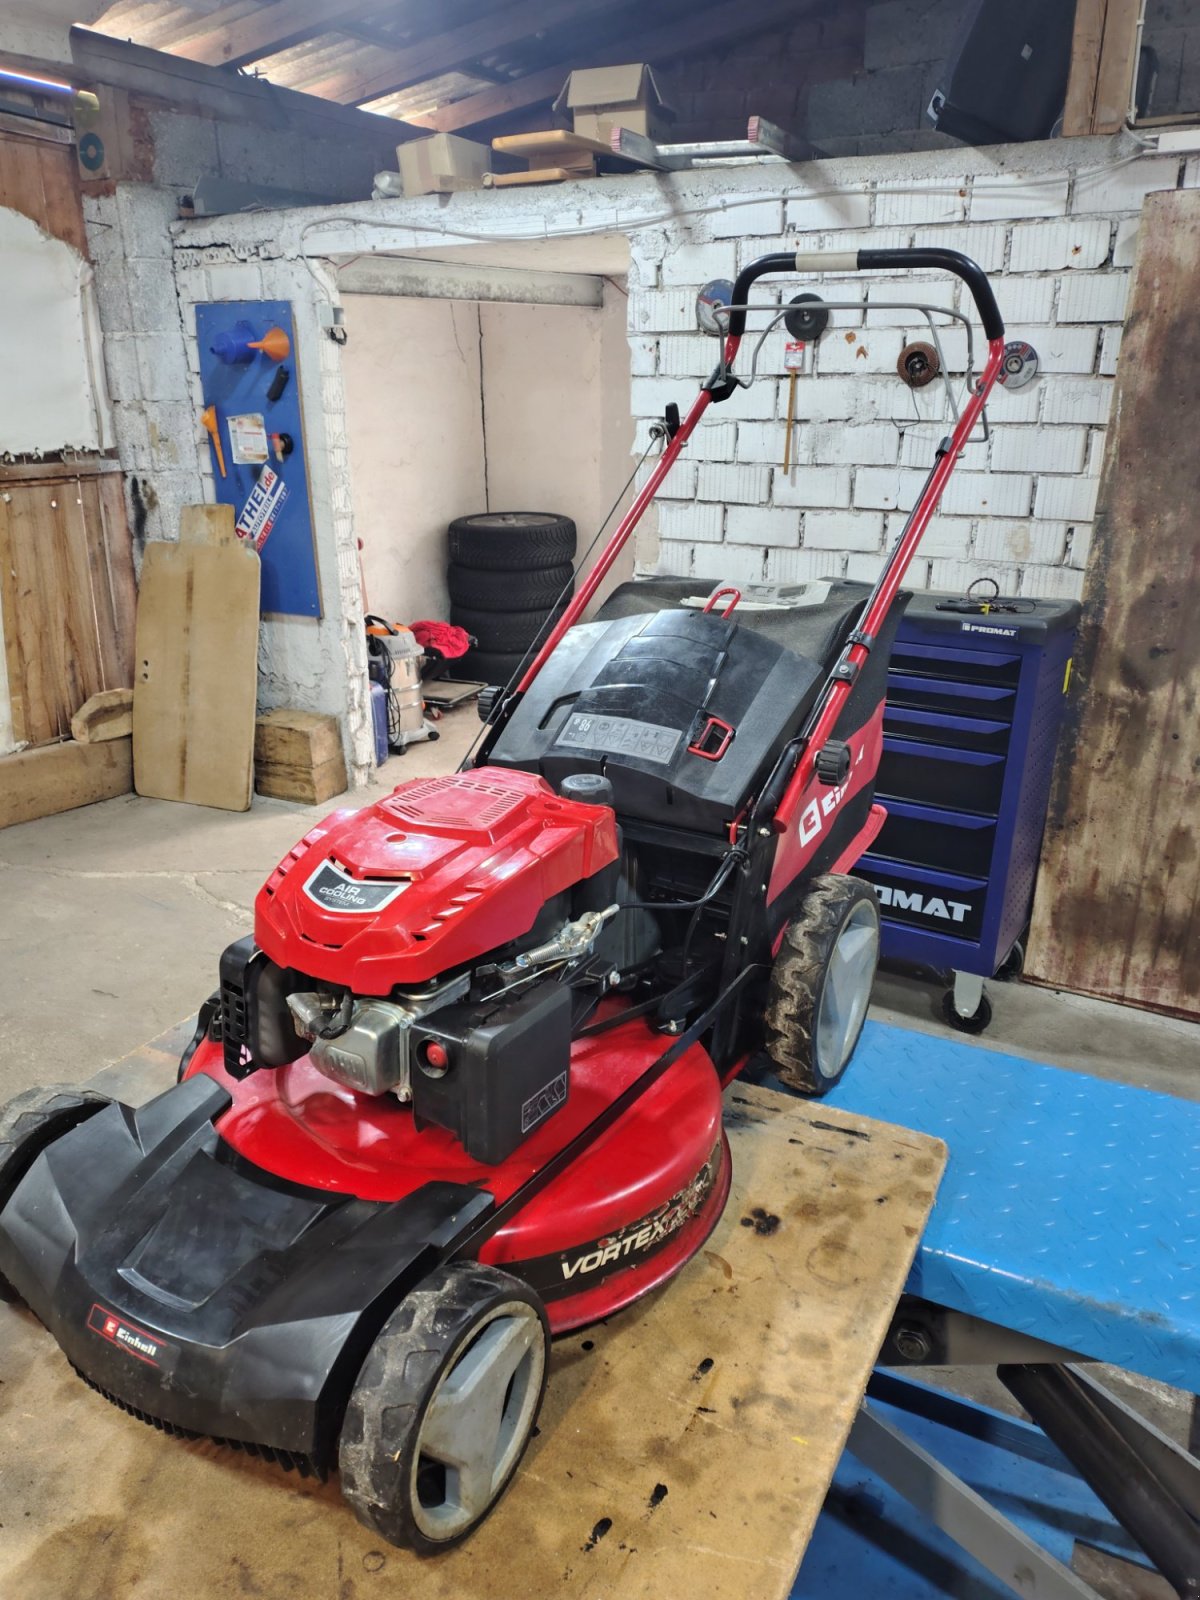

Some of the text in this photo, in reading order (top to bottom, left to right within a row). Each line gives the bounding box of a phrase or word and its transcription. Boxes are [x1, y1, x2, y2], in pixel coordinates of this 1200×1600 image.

[971, 625, 1017, 637] PROMAT
[319, 887, 366, 905] COOLING
[334, 883, 361, 896] AIR
[324, 896, 350, 906] SYSTEM
[873, 884, 972, 922] OMAT
[562, 1220, 666, 1280] VORTEX
[116, 1328, 157, 1356] Einhell
